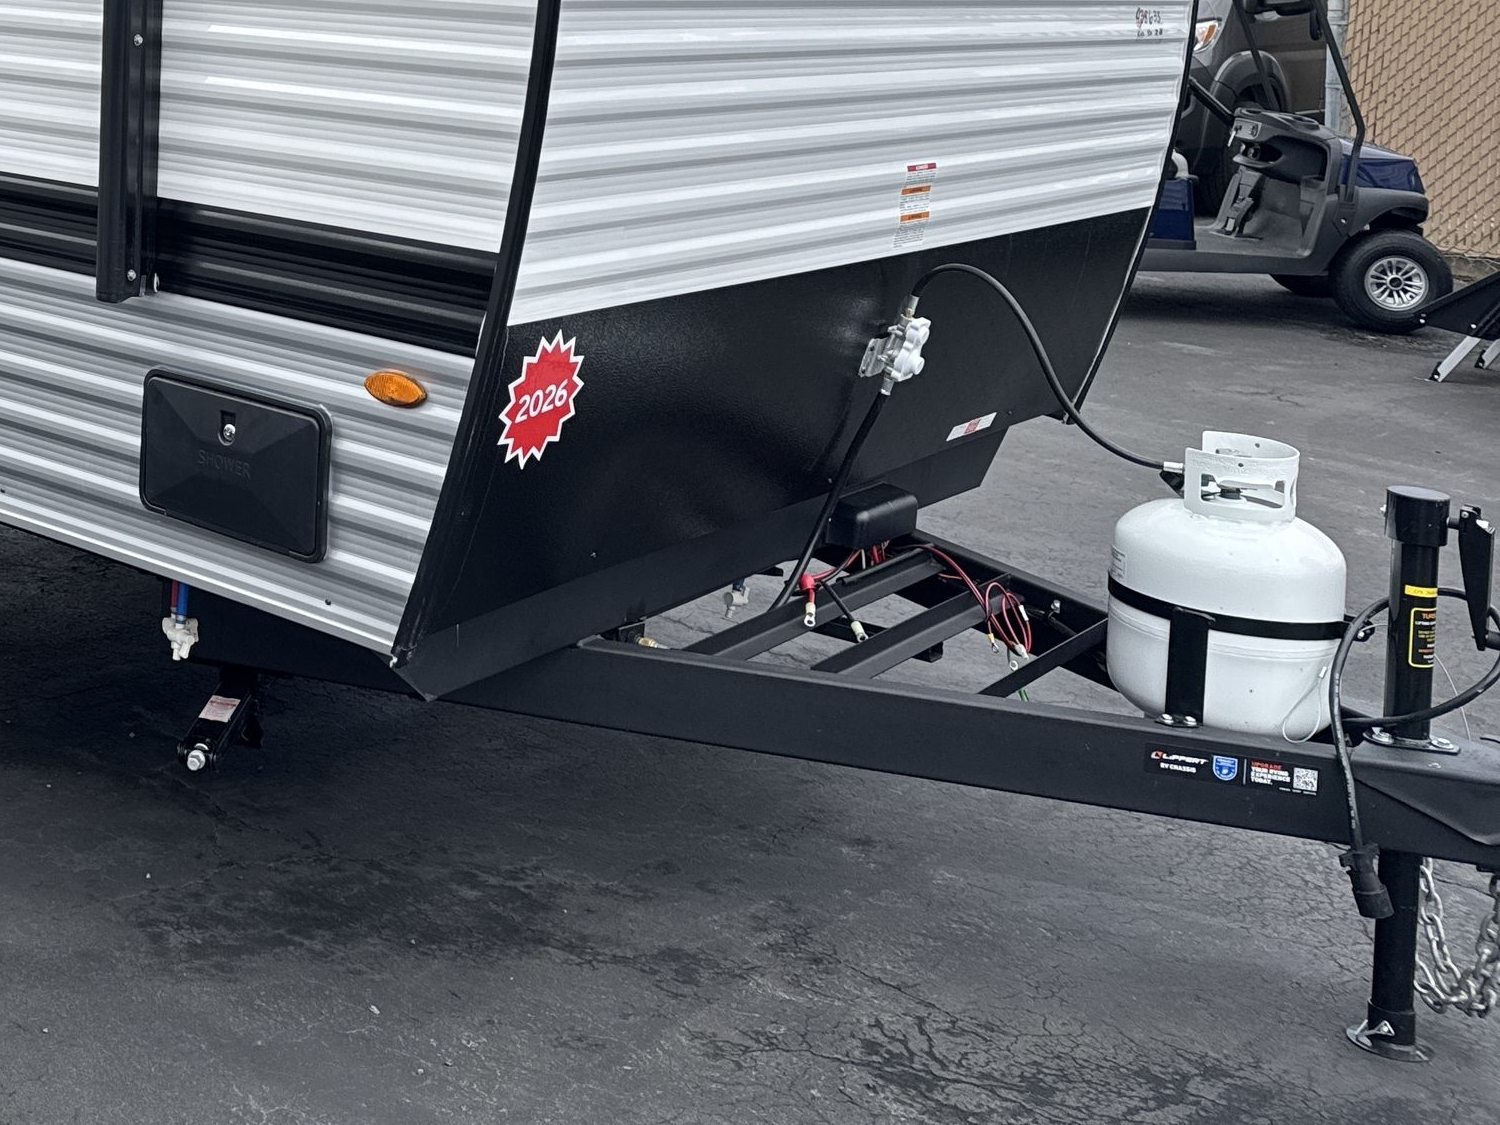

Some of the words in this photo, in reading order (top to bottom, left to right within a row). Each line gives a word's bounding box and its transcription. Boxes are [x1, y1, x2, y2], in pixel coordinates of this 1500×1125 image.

[514, 378, 569, 424] 2026
[197, 448, 252, 481] SHOWER
[1163, 753, 1209, 765] LIPPERT
[1251, 761, 1282, 769] UPGRADE
